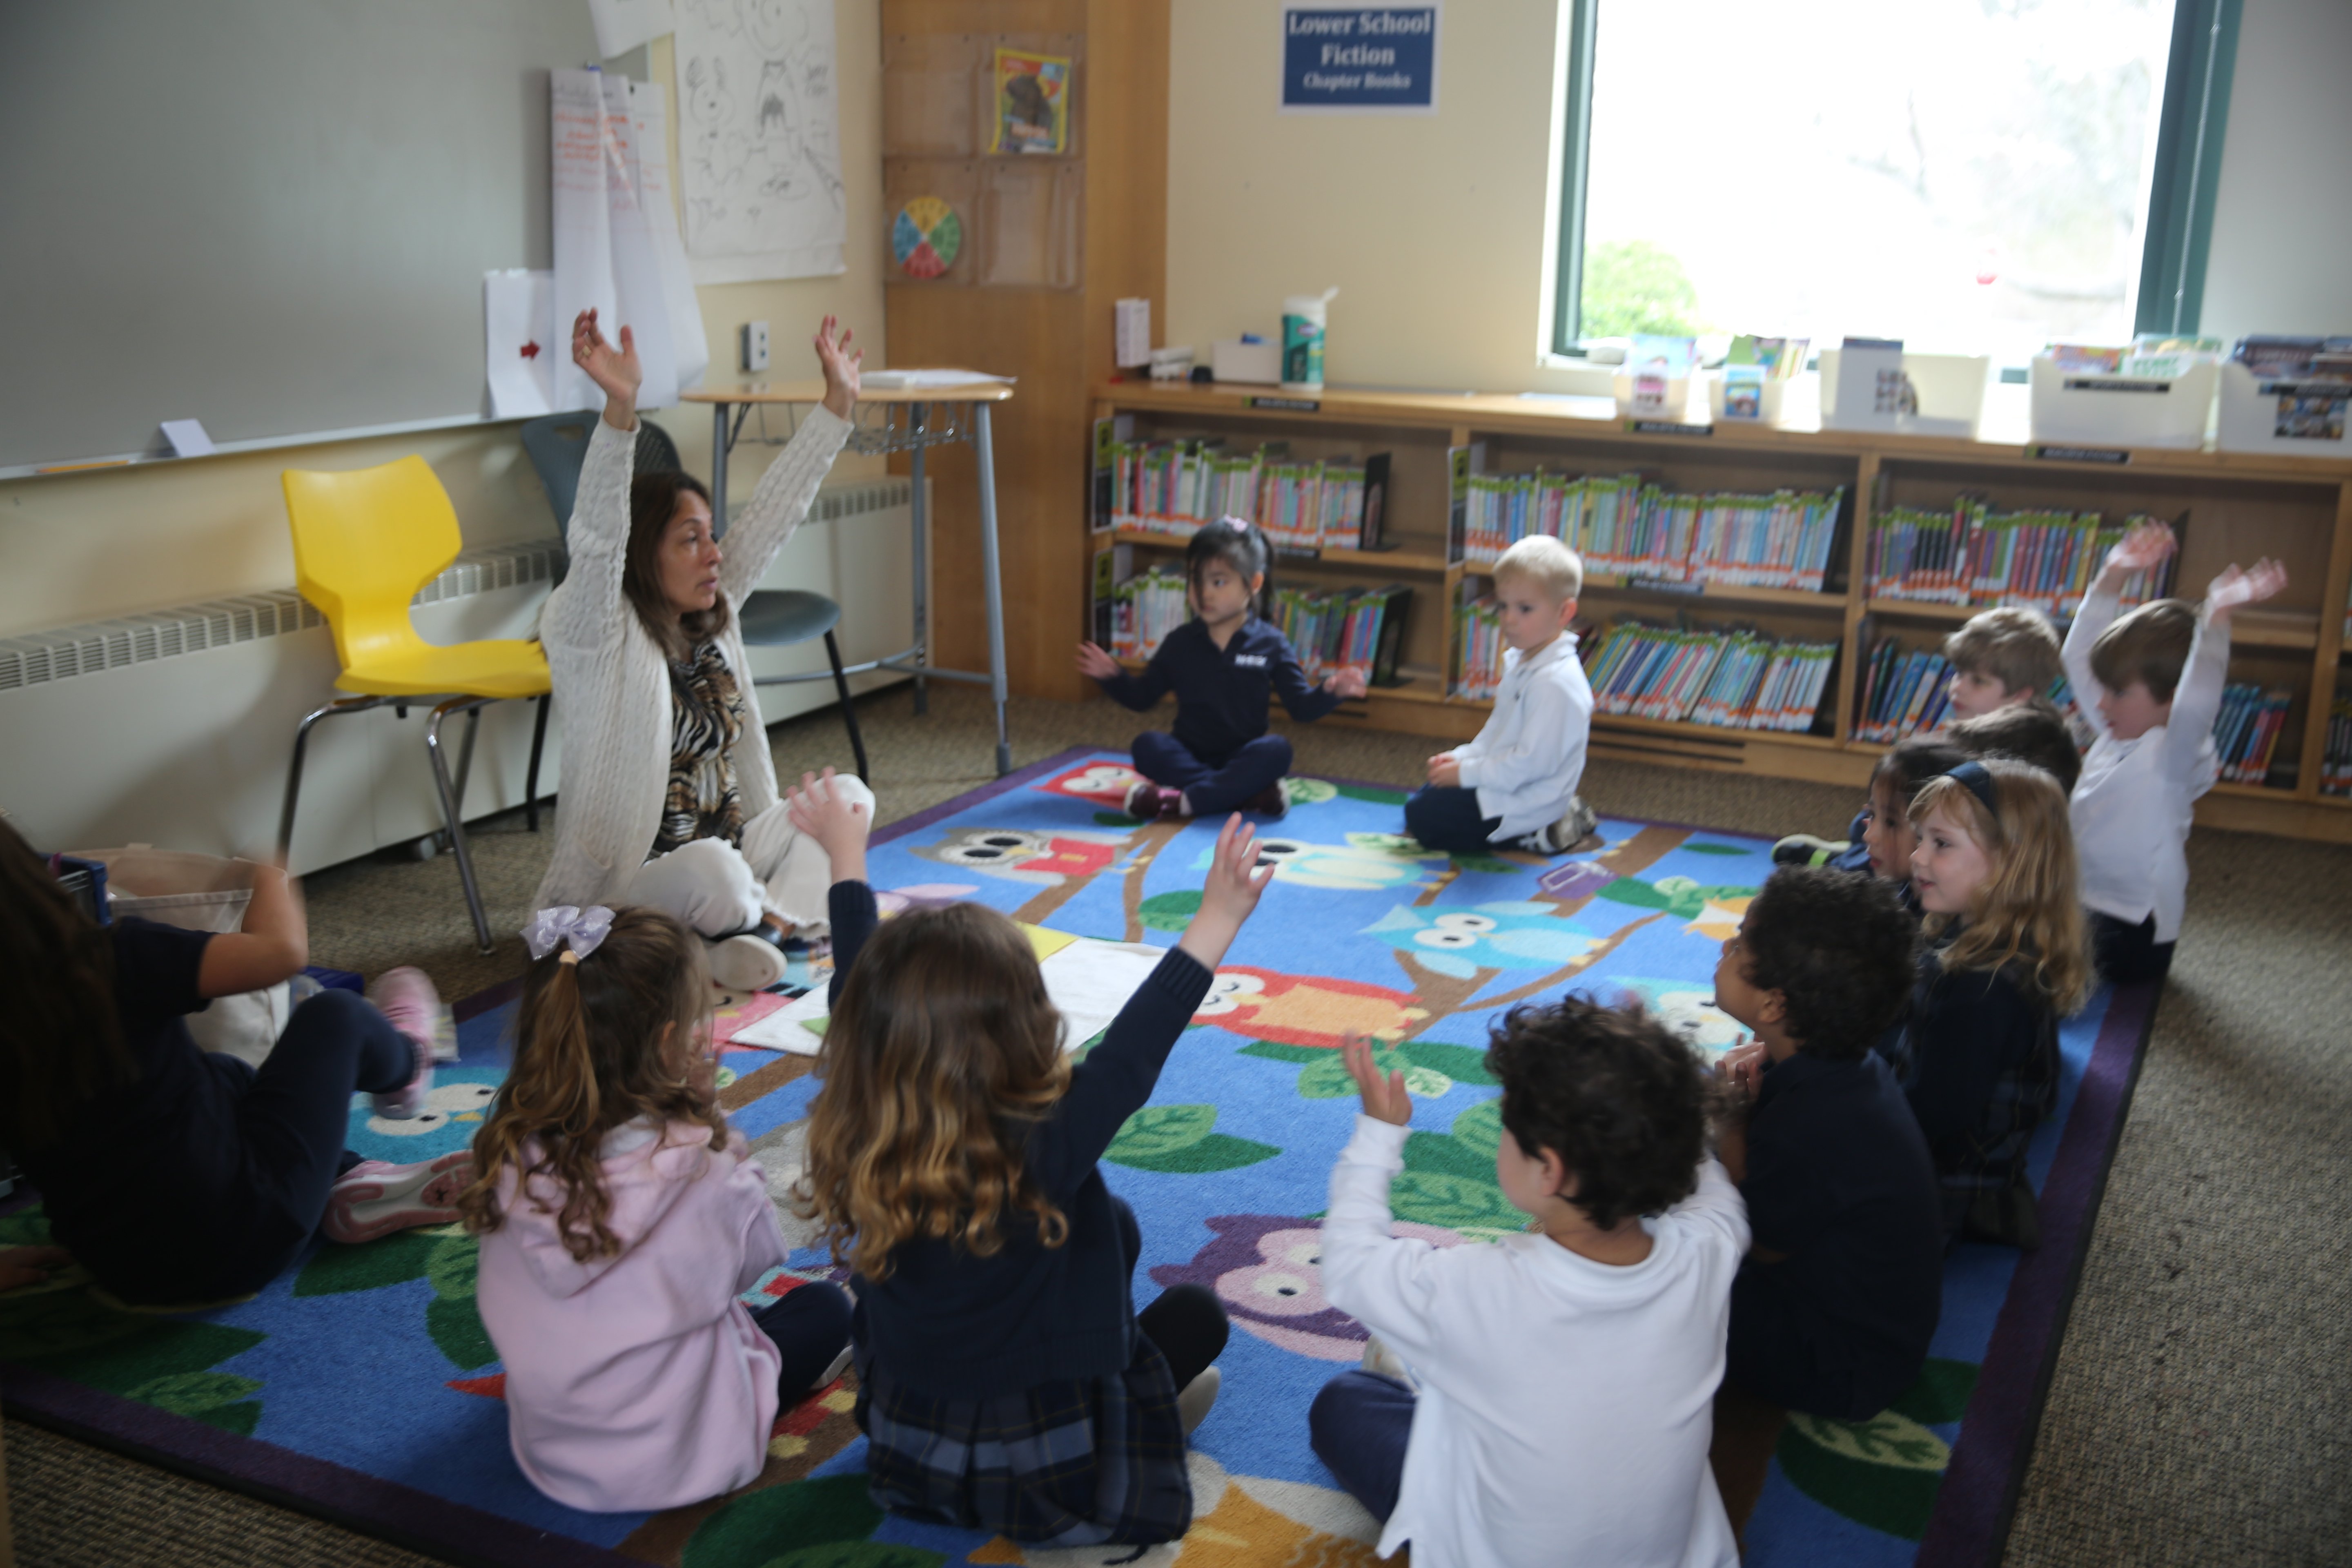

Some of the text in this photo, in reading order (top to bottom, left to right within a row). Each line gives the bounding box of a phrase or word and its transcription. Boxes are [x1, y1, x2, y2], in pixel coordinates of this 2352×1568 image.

[1289, 11, 1430, 36] Lower School
[1321, 43, 1395, 66] Fiction
